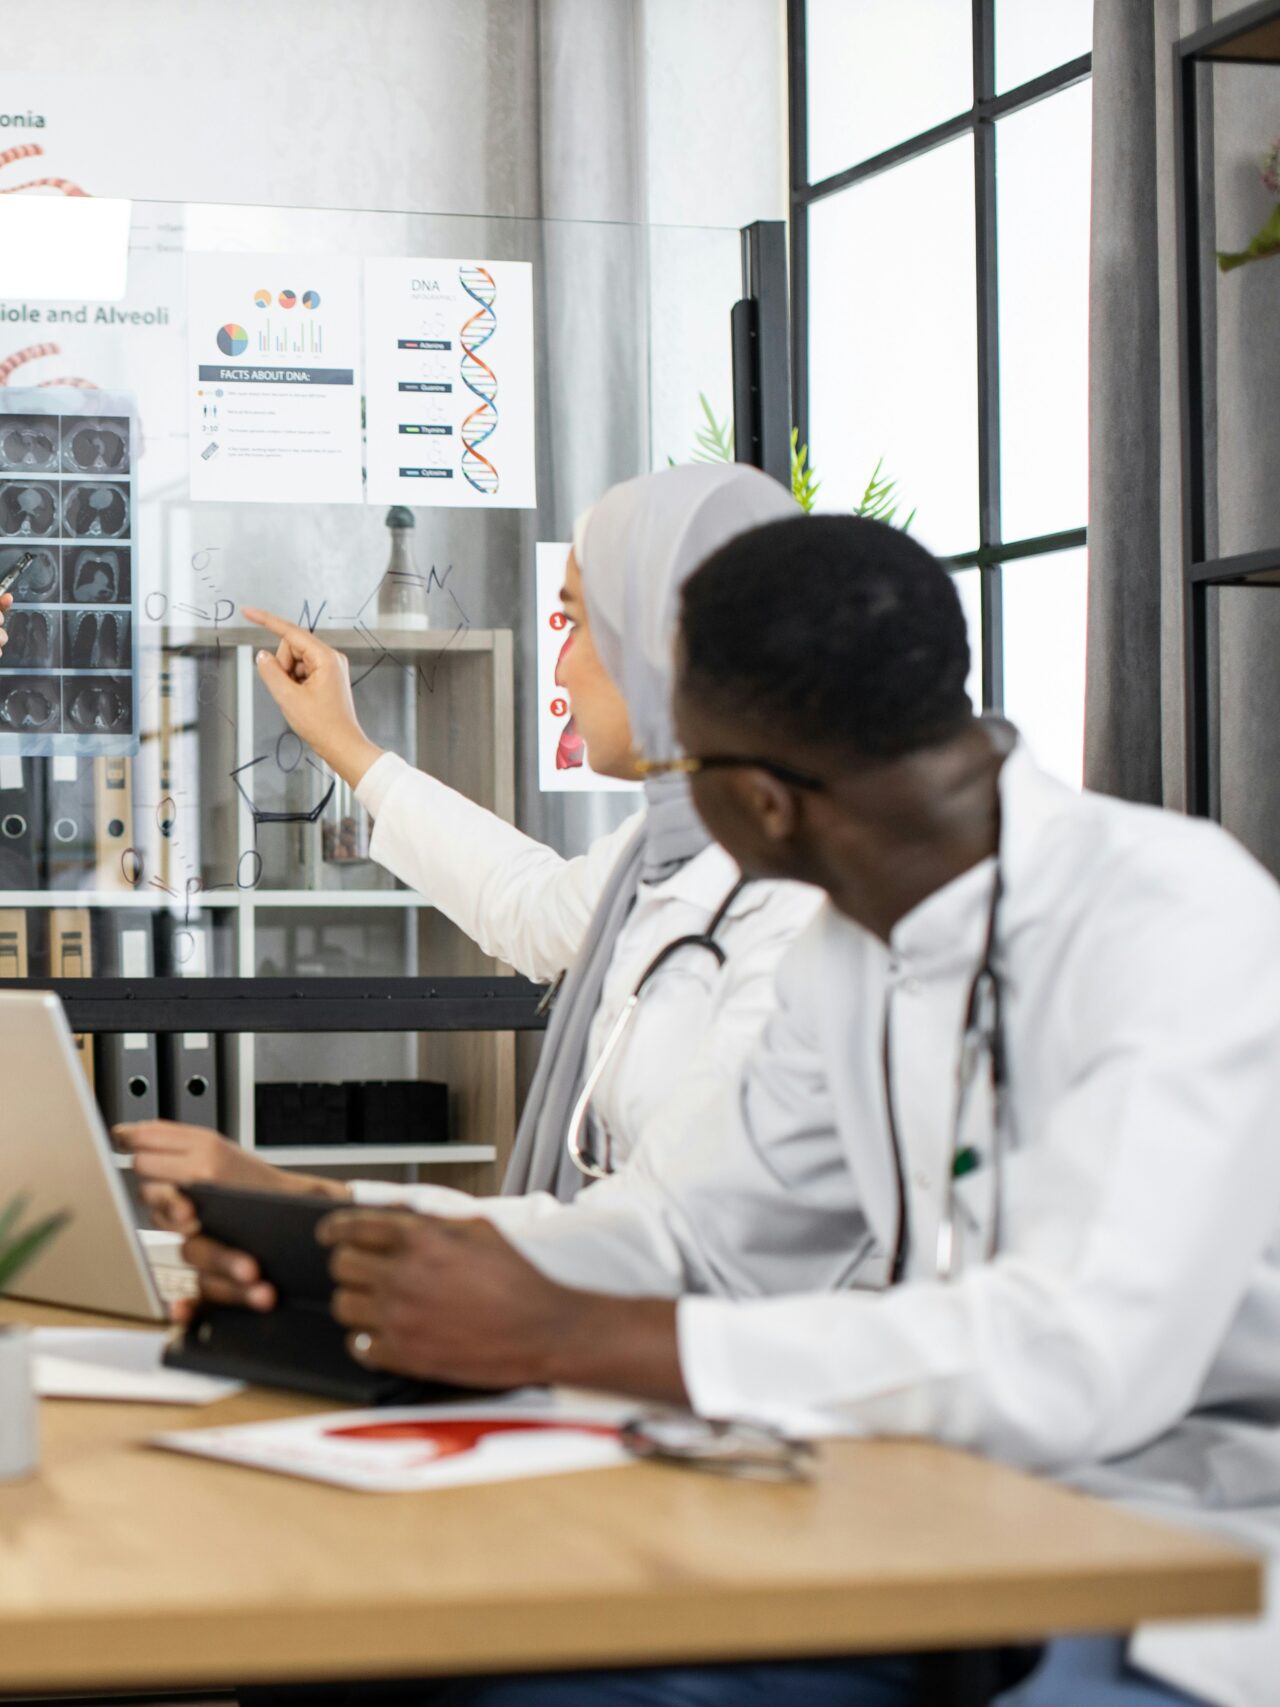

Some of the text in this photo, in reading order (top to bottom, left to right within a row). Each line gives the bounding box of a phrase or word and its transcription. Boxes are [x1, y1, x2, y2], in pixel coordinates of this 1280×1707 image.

[411, 279, 441, 292] DNA
[46, 306, 87, 324] and
[93, 307, 169, 326] Alveoli
[220, 369, 250, 380] FACTS
[251, 370, 285, 381] ABOUT
